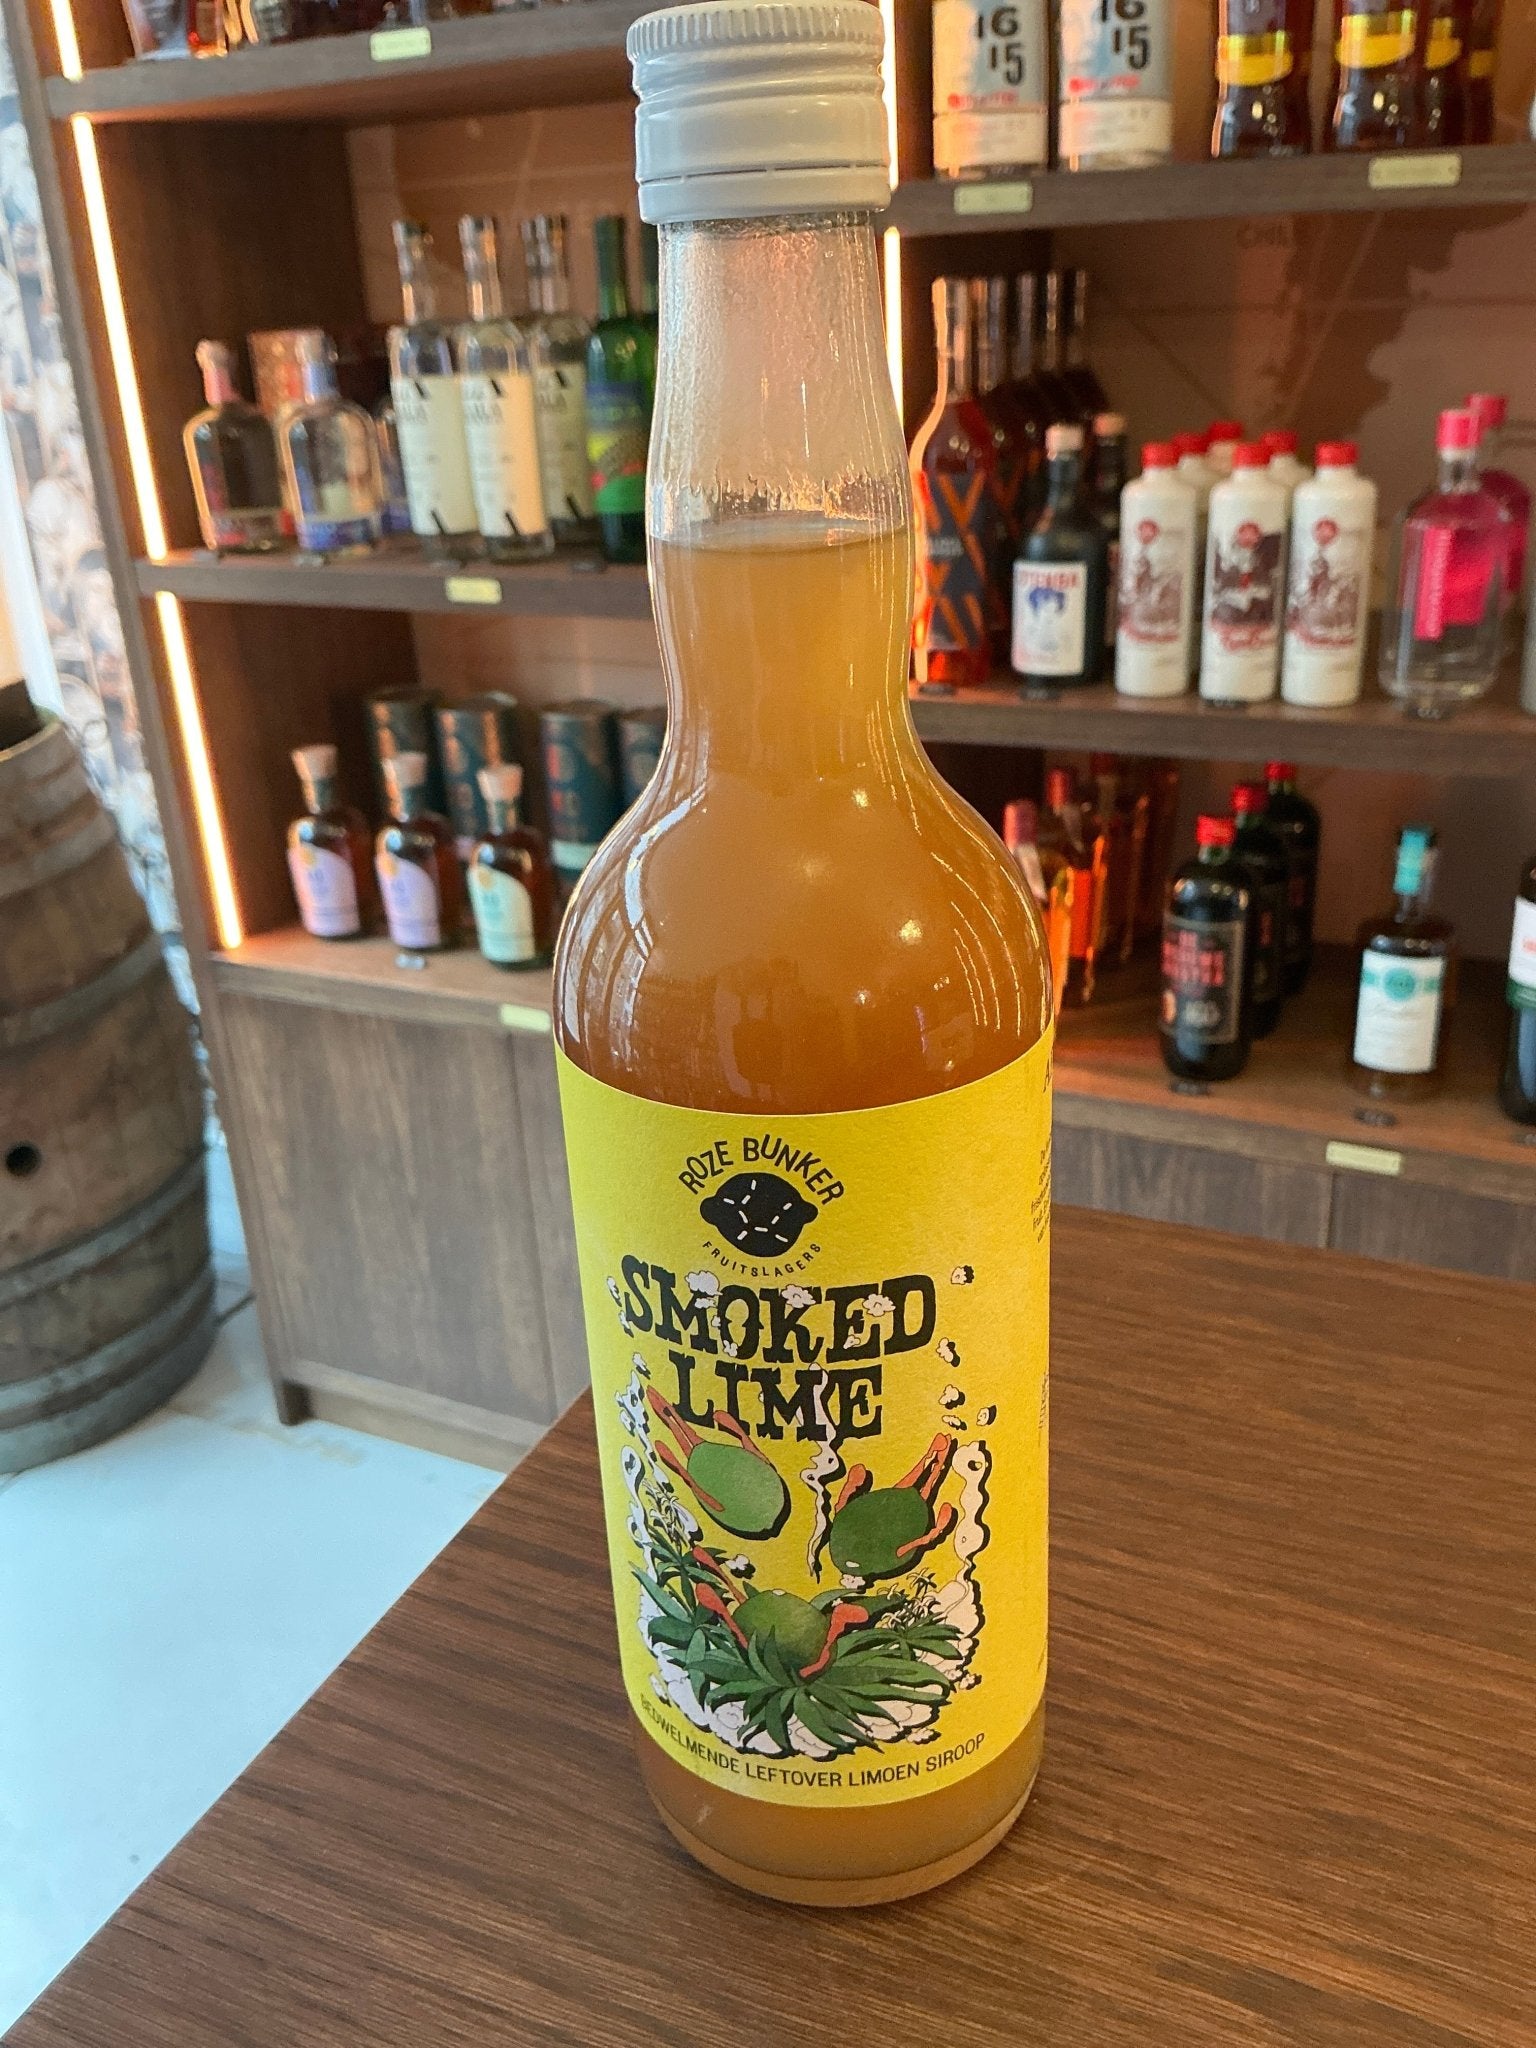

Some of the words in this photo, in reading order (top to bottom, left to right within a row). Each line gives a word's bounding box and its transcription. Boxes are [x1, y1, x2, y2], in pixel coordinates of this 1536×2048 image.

[991, 43, 1023, 85] 15
[1113, 25, 1149, 70] 15
[678, 1140, 734, 1195] ROZE
[743, 1134, 845, 1205] BUNKER
[702, 1241, 821, 1277] FRUITSLAGERS
[621, 1254, 937, 1364] SMOKED
[668, 1349, 882, 1442] LIME
[746, 1762, 842, 1787] LEFTOVER
[849, 1761, 920, 1787] LIMOEN
[926, 1732, 985, 1772] SIROOP
